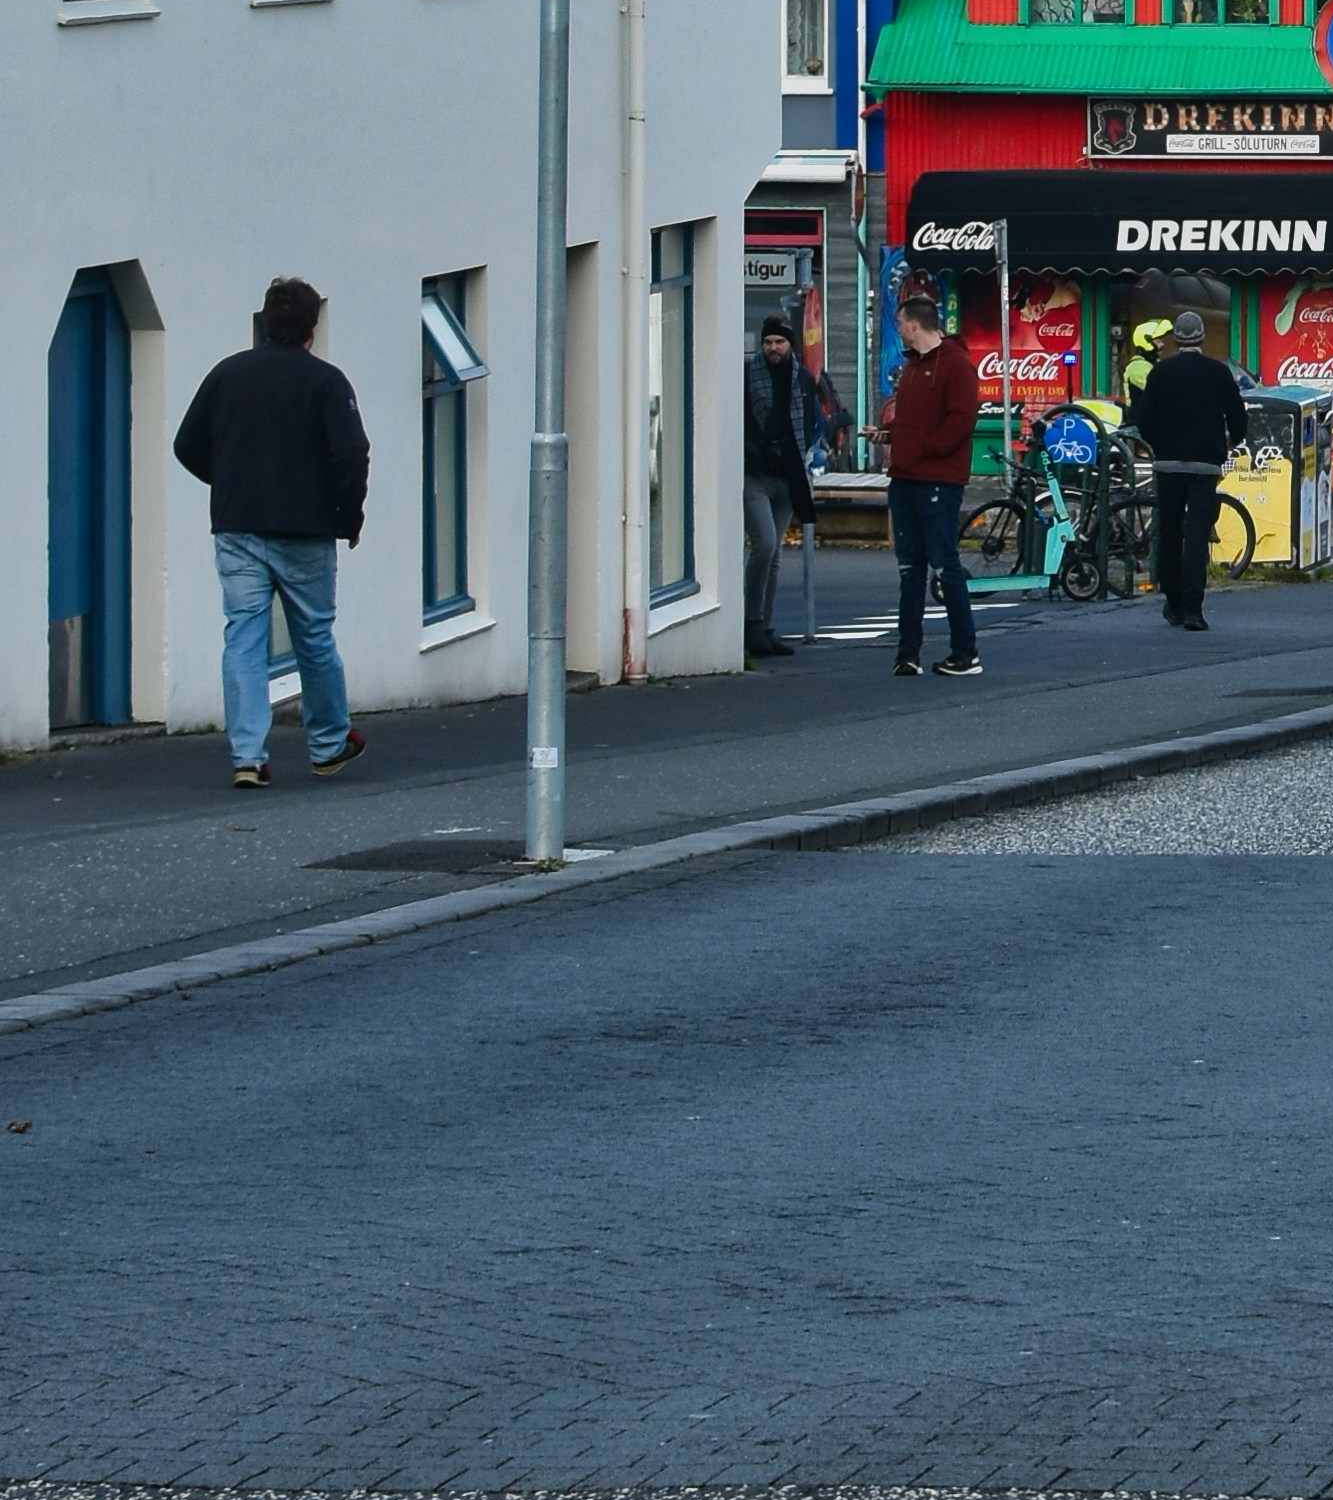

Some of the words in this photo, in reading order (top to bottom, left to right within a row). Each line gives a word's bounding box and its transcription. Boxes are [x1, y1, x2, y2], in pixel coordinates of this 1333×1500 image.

[912, 221, 996, 252] Coca-Cola
[1116, 220, 1328, 252] DREKINN
[1038, 323, 1074, 337] Coca-Cola
[1017, 386, 1046, 396] EVERY
[1050, 386, 1066, 396] DAY
[1063, 419, 1076, 437] P
